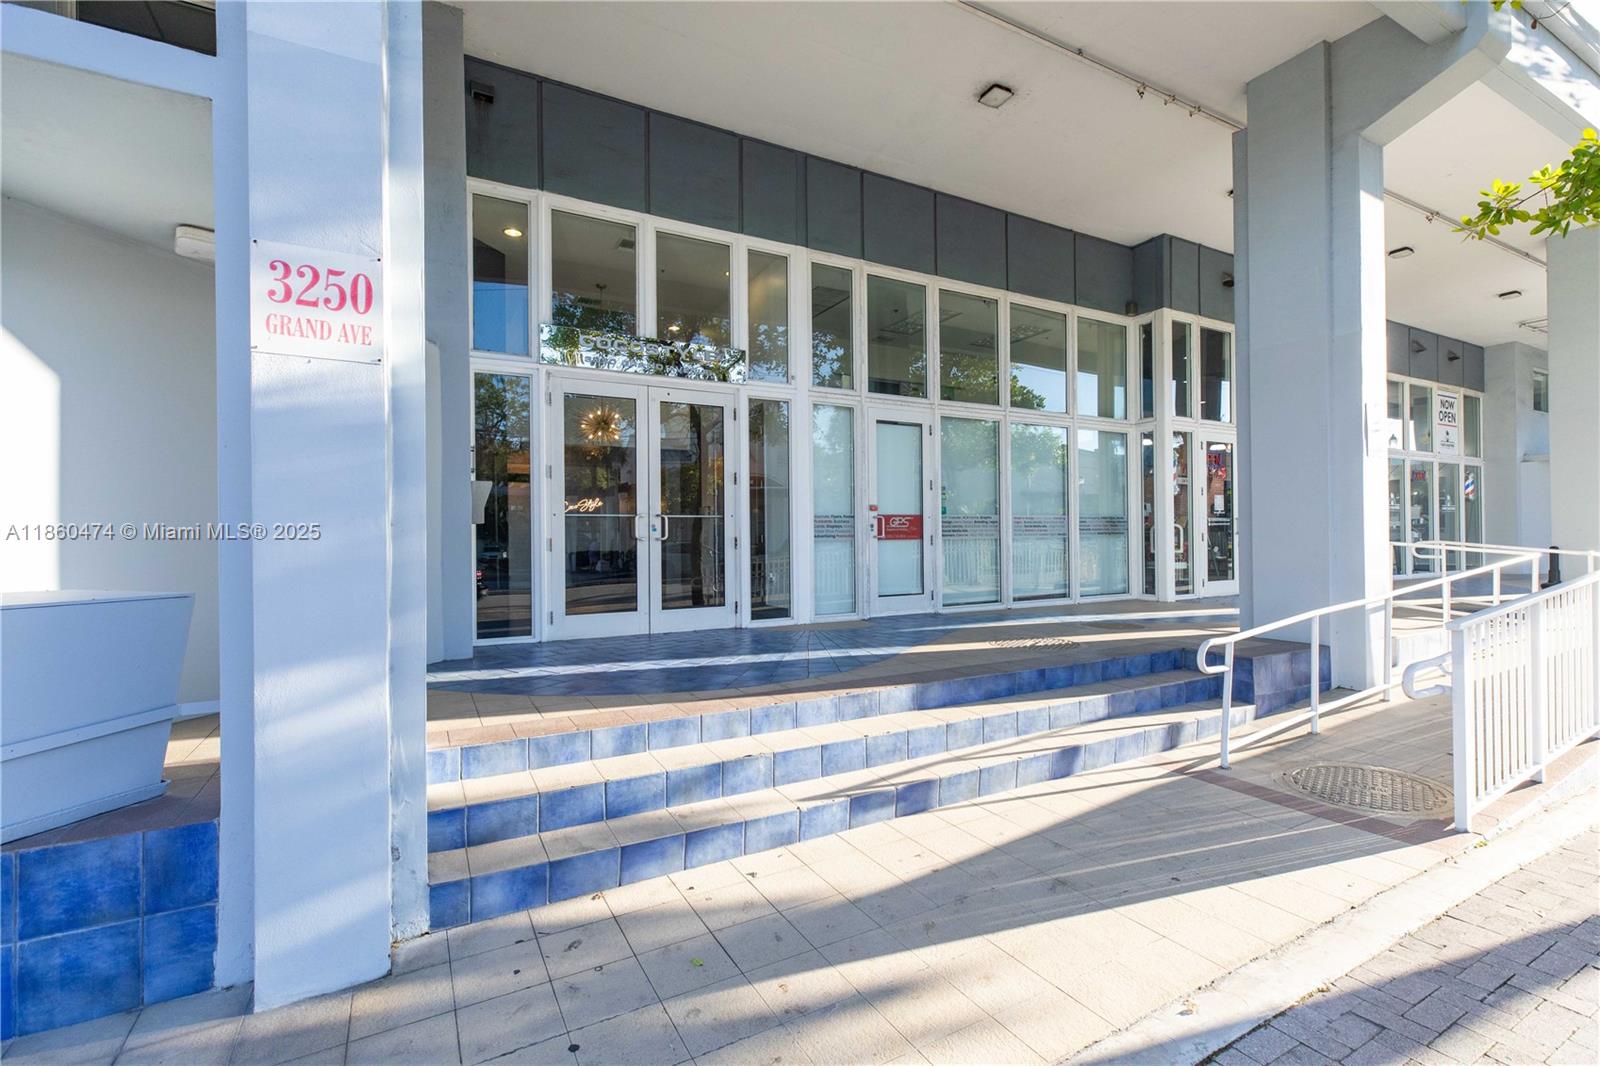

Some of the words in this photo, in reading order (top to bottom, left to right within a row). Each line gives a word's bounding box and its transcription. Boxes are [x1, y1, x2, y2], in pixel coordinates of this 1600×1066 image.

[267, 259, 373, 315] 3250
[265, 312, 332, 341] GRAND
[337, 322, 373, 346] AVE
[1440, 399, 1455, 410] NOW
[1439, 410, 1456, 424] OPEN
